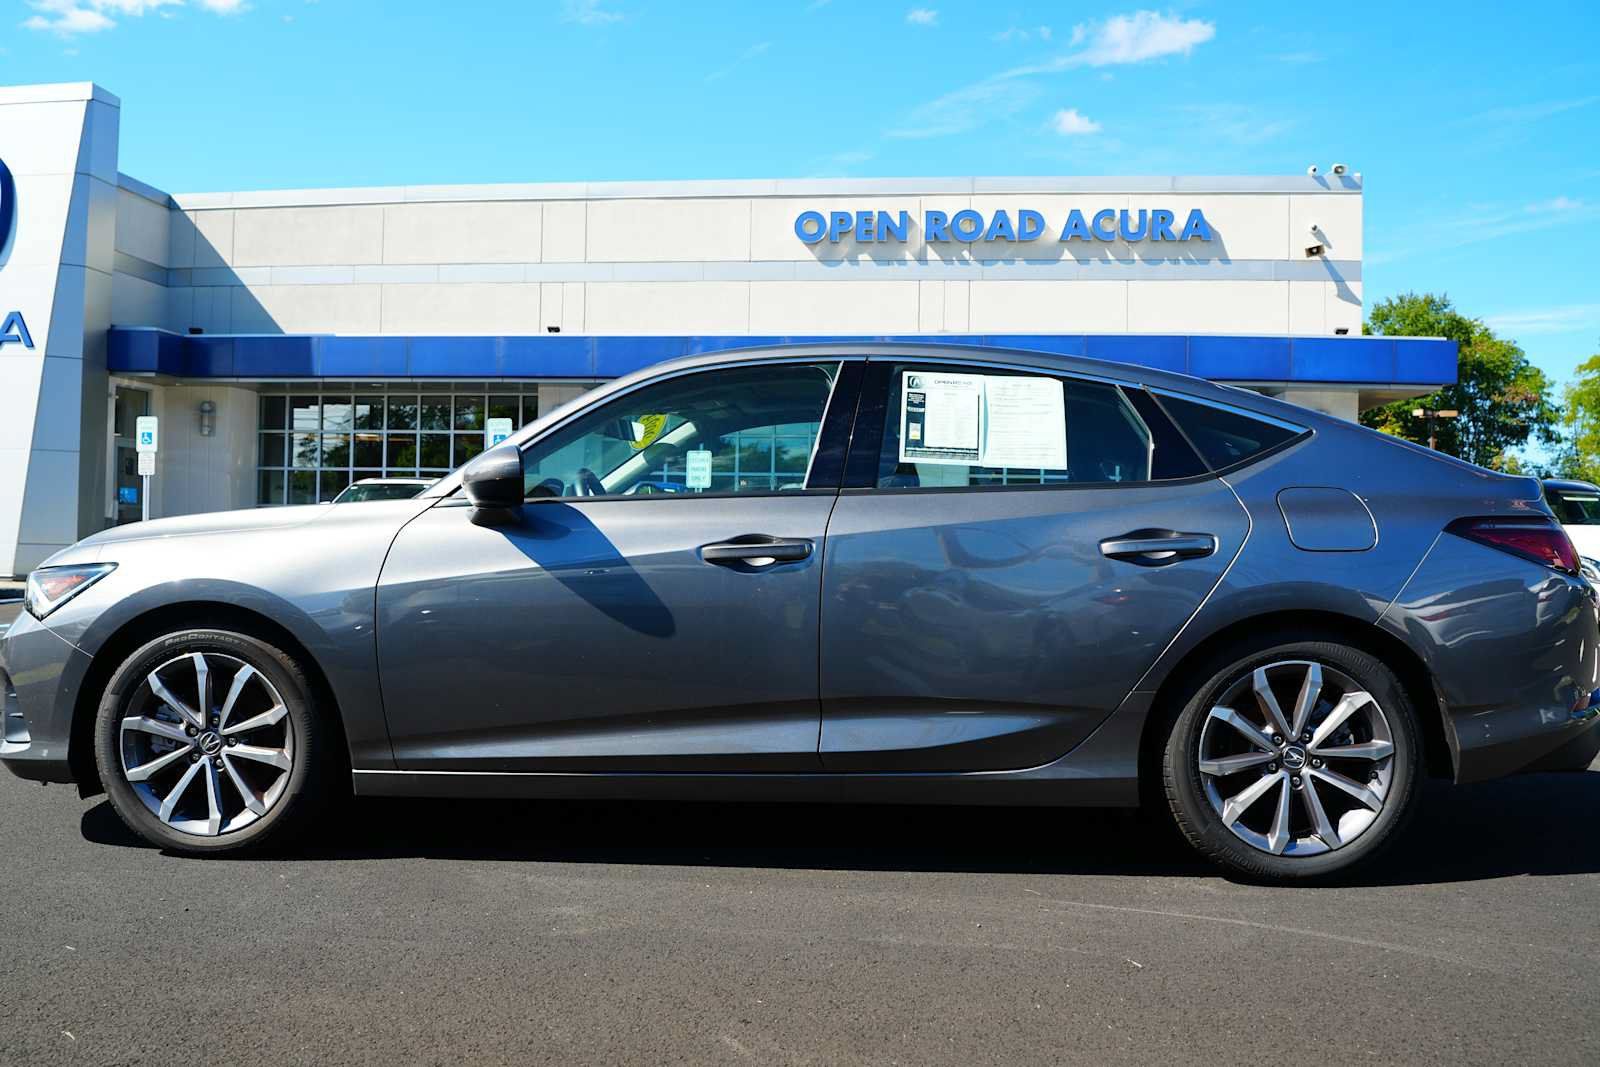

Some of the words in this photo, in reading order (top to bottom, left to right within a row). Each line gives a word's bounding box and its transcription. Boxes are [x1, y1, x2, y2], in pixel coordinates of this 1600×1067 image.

[794, 210, 909, 243] OPEN
[925, 209, 1046, 243] ROAD
[1060, 208, 1213, 242] ACURA
